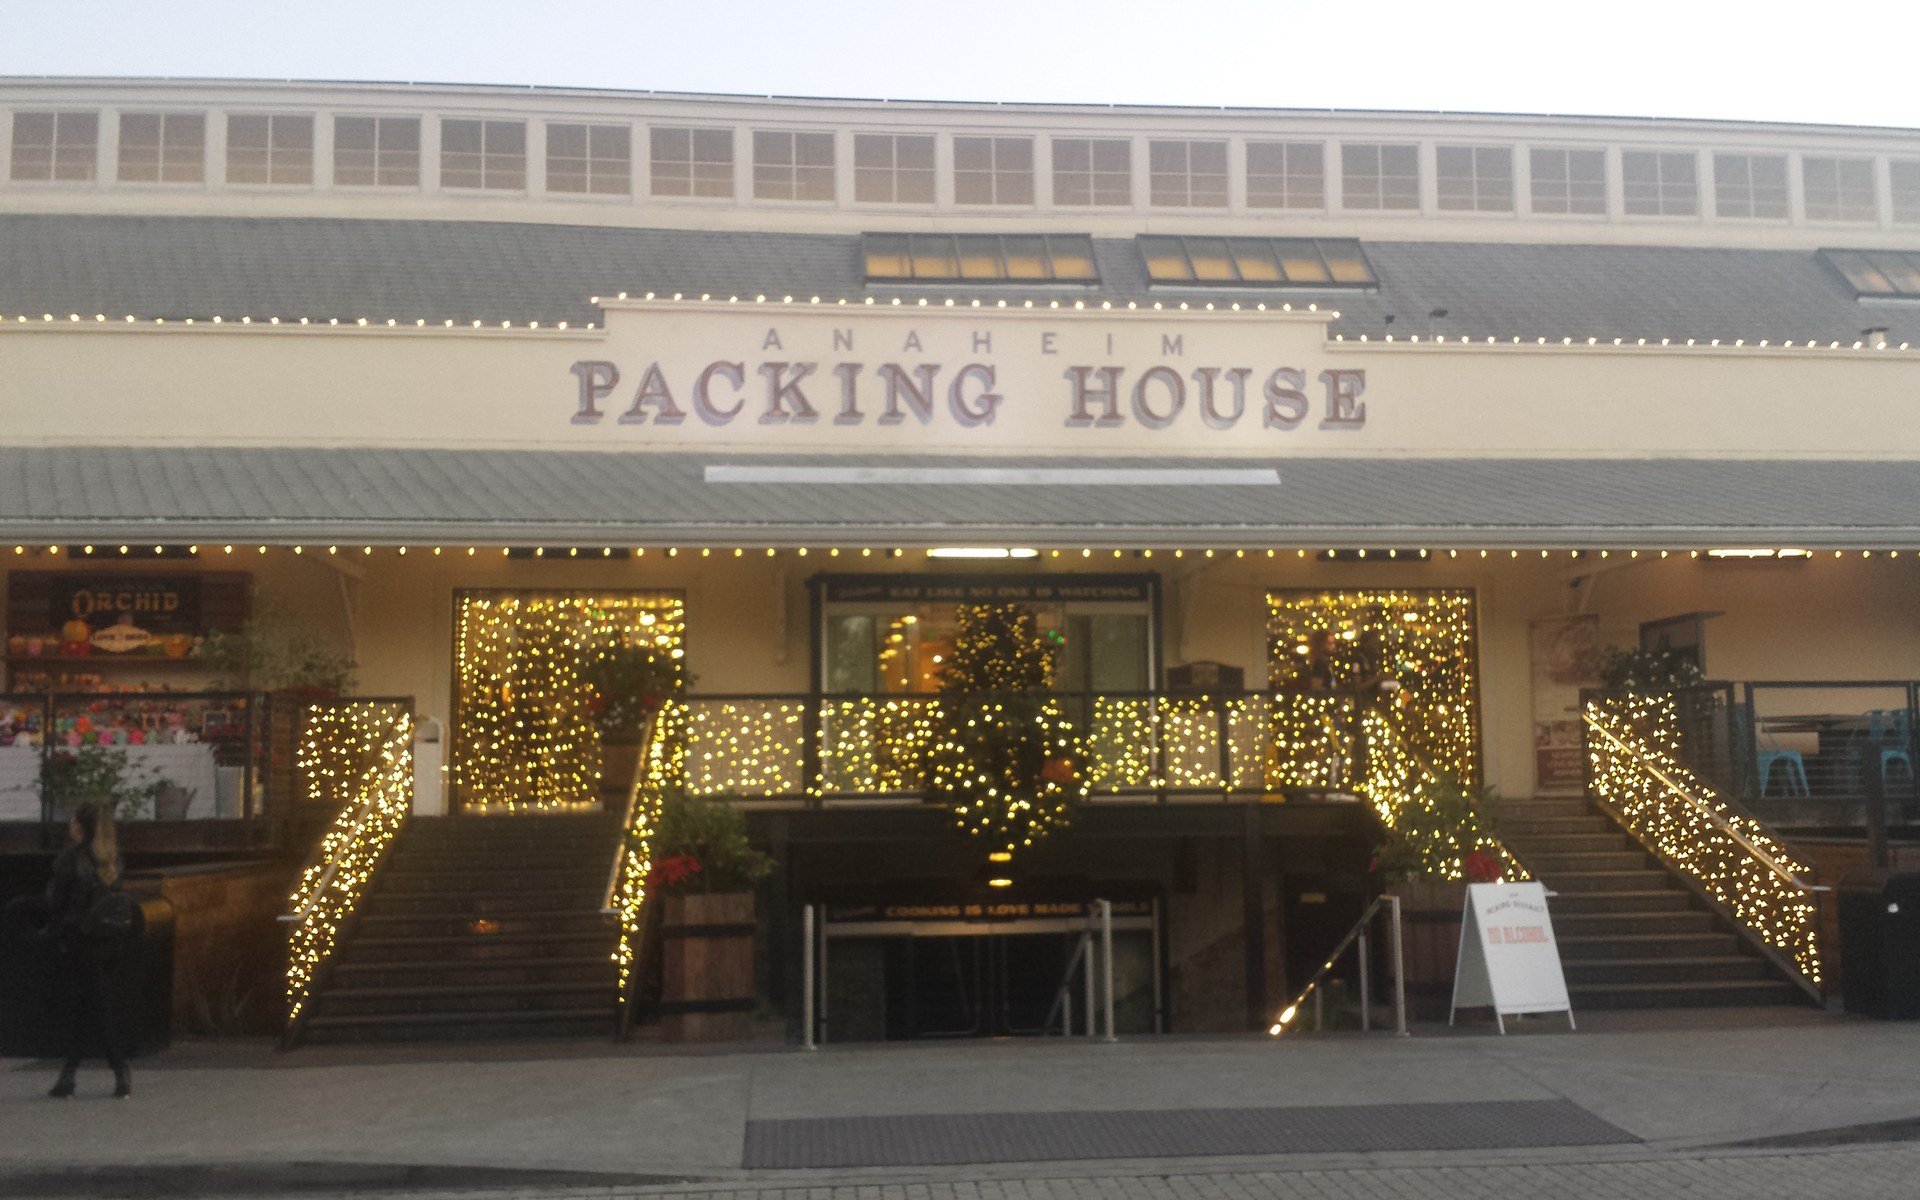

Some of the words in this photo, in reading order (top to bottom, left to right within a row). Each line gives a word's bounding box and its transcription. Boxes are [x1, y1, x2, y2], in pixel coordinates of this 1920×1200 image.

[762, 328, 1184, 356] ANAHEIM
[569, 360, 1004, 428] PACKING
[1062, 365, 1367, 431] HOUSE
[72, 590, 179, 617] ORCHID
[889, 587, 920, 598] EAT
[926, 587, 964, 598] LIKE
[970, 587, 992, 598] NO
[997, 587, 1030, 598] ONE
[1036, 587, 1052, 597] IS
[1057, 587, 1140, 598] WATCHING
[885, 906, 959, 917] COOKING
[965, 904, 981, 916] IS
[988, 903, 1030, 915] LOVE
[1034, 902, 1080, 913] MADE
